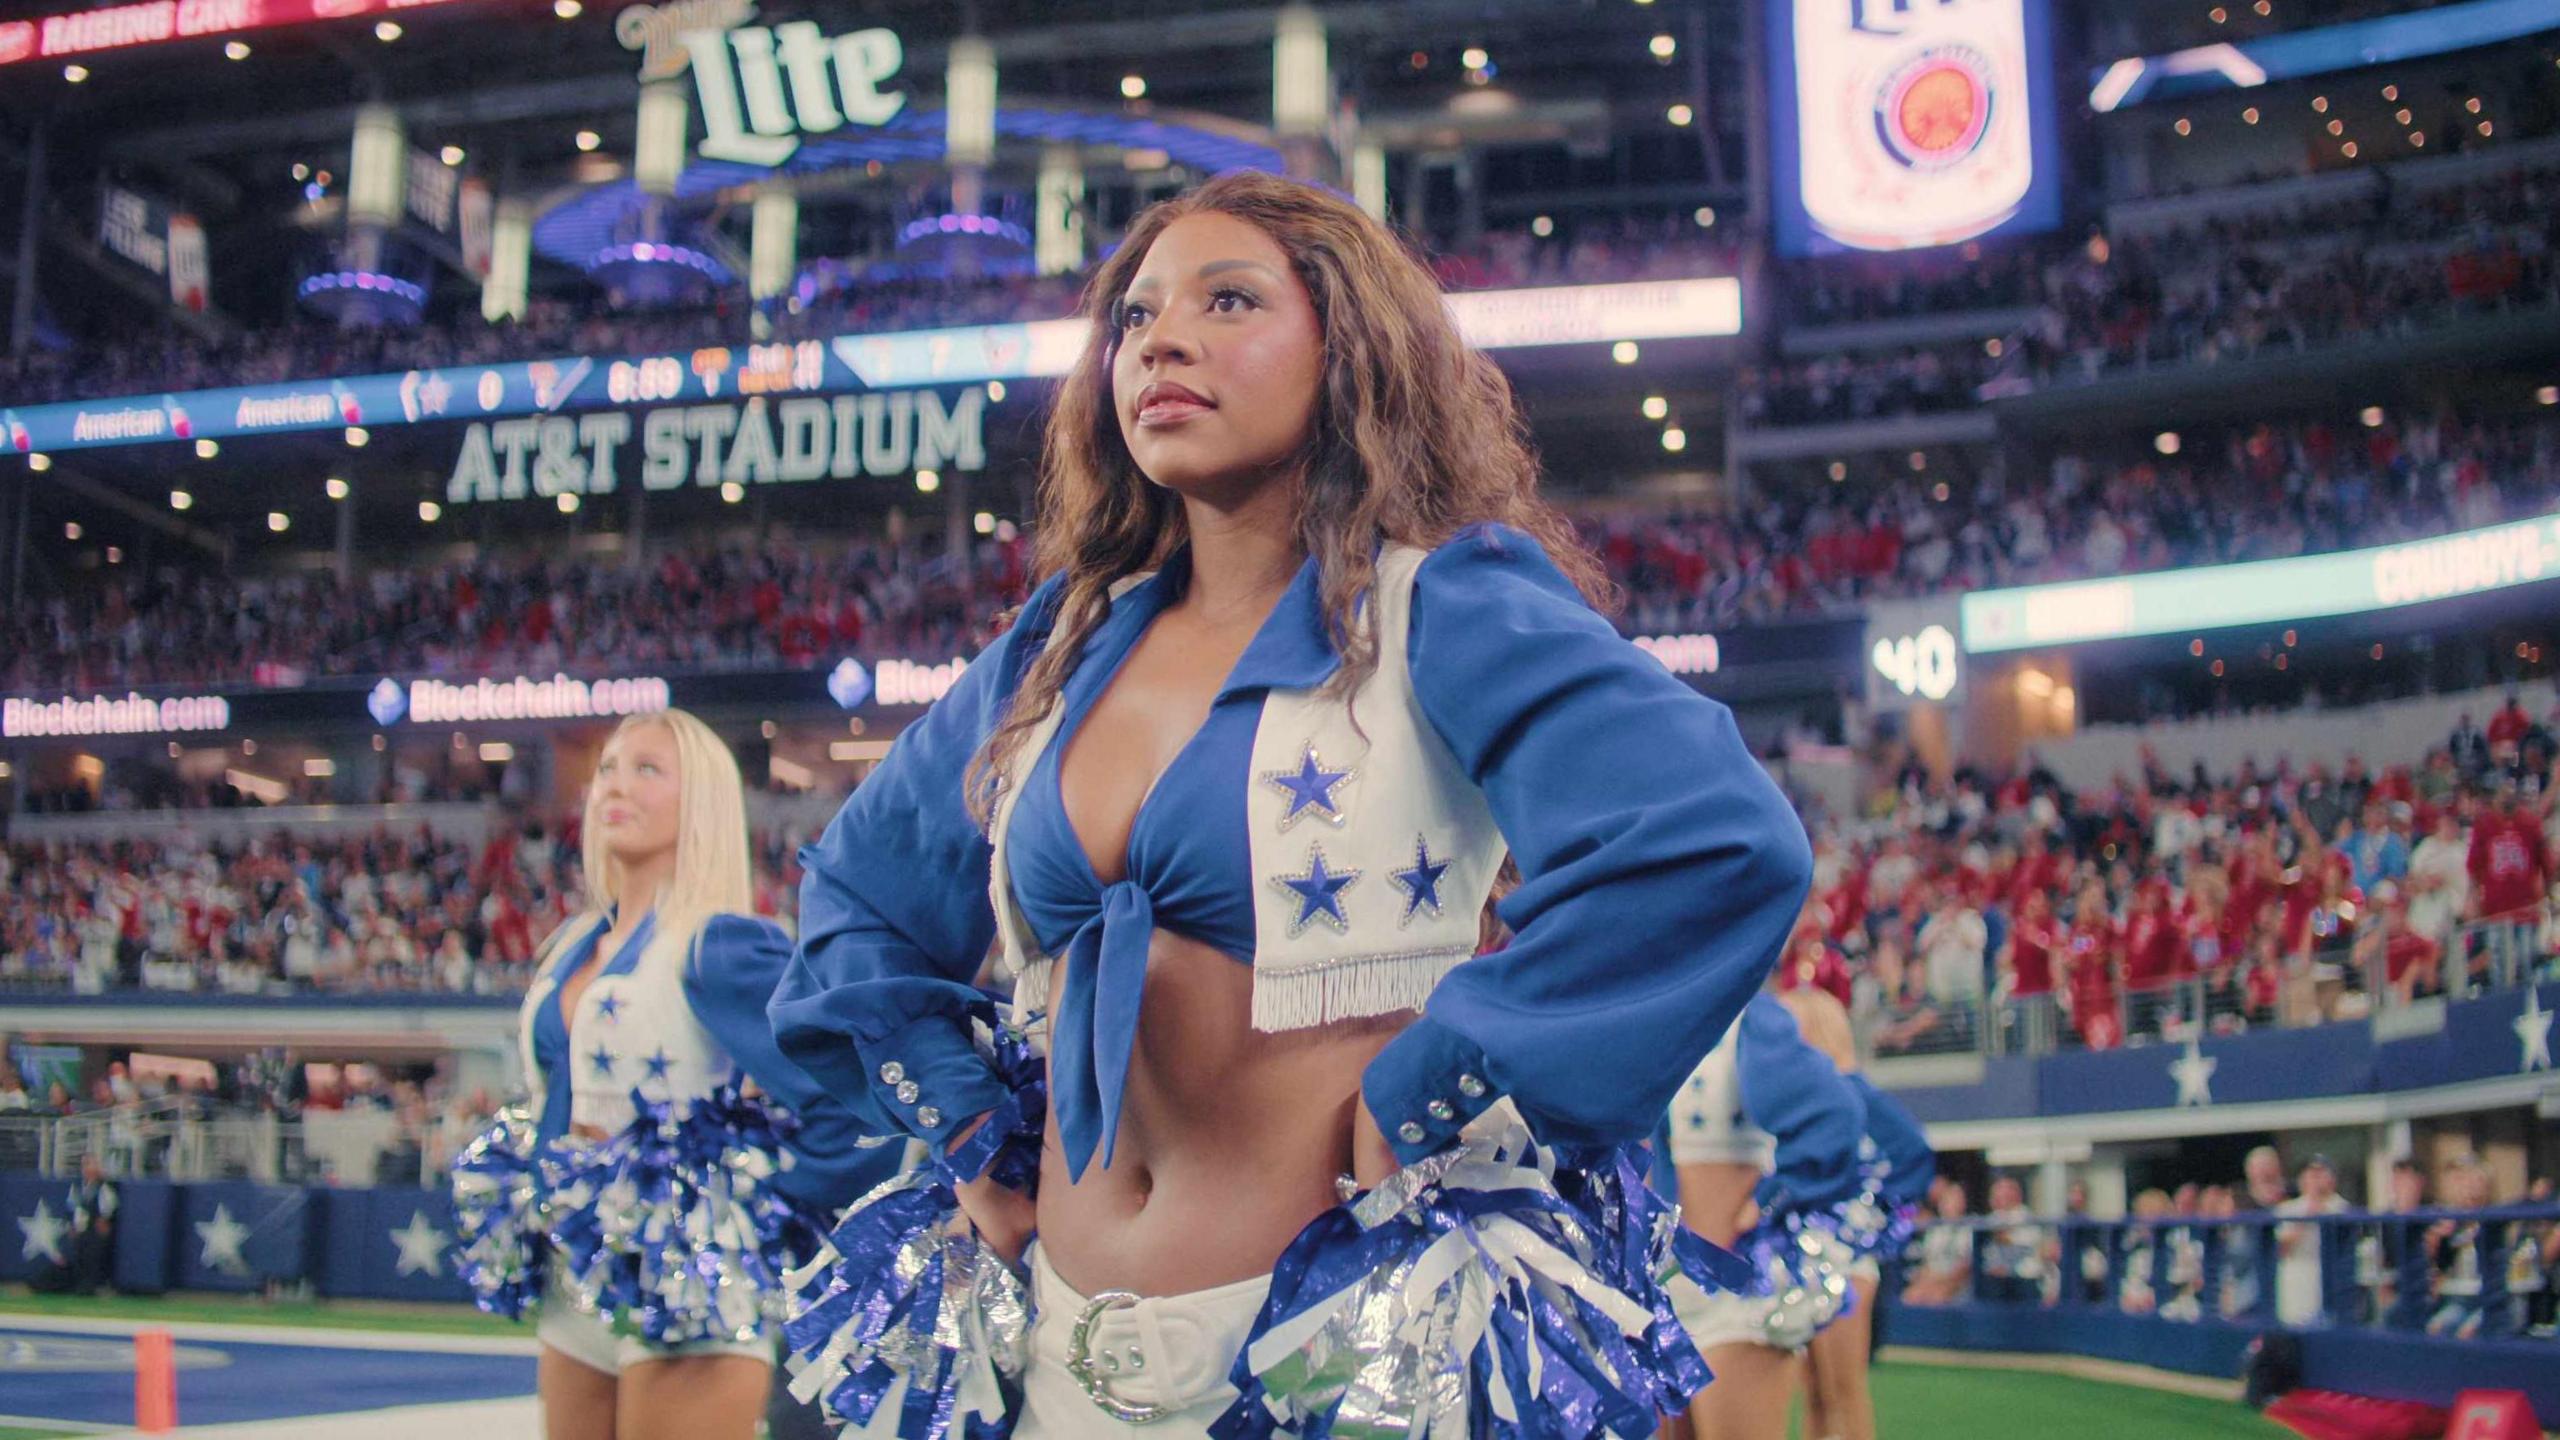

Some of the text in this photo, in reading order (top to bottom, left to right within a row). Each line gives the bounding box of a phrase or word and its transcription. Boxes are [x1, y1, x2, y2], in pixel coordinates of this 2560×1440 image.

[41, 2, 176, 56] RAISING
[682, 20, 906, 167] Lite
[74, 392, 336, 442] American American
[447, 386, 987, 502] AT&T STADIUM
[1873, 625, 1957, 699] 40
[2, 691, 230, 737] Blockchain.com
[409, 672, 669, 723] Blockchain.com
